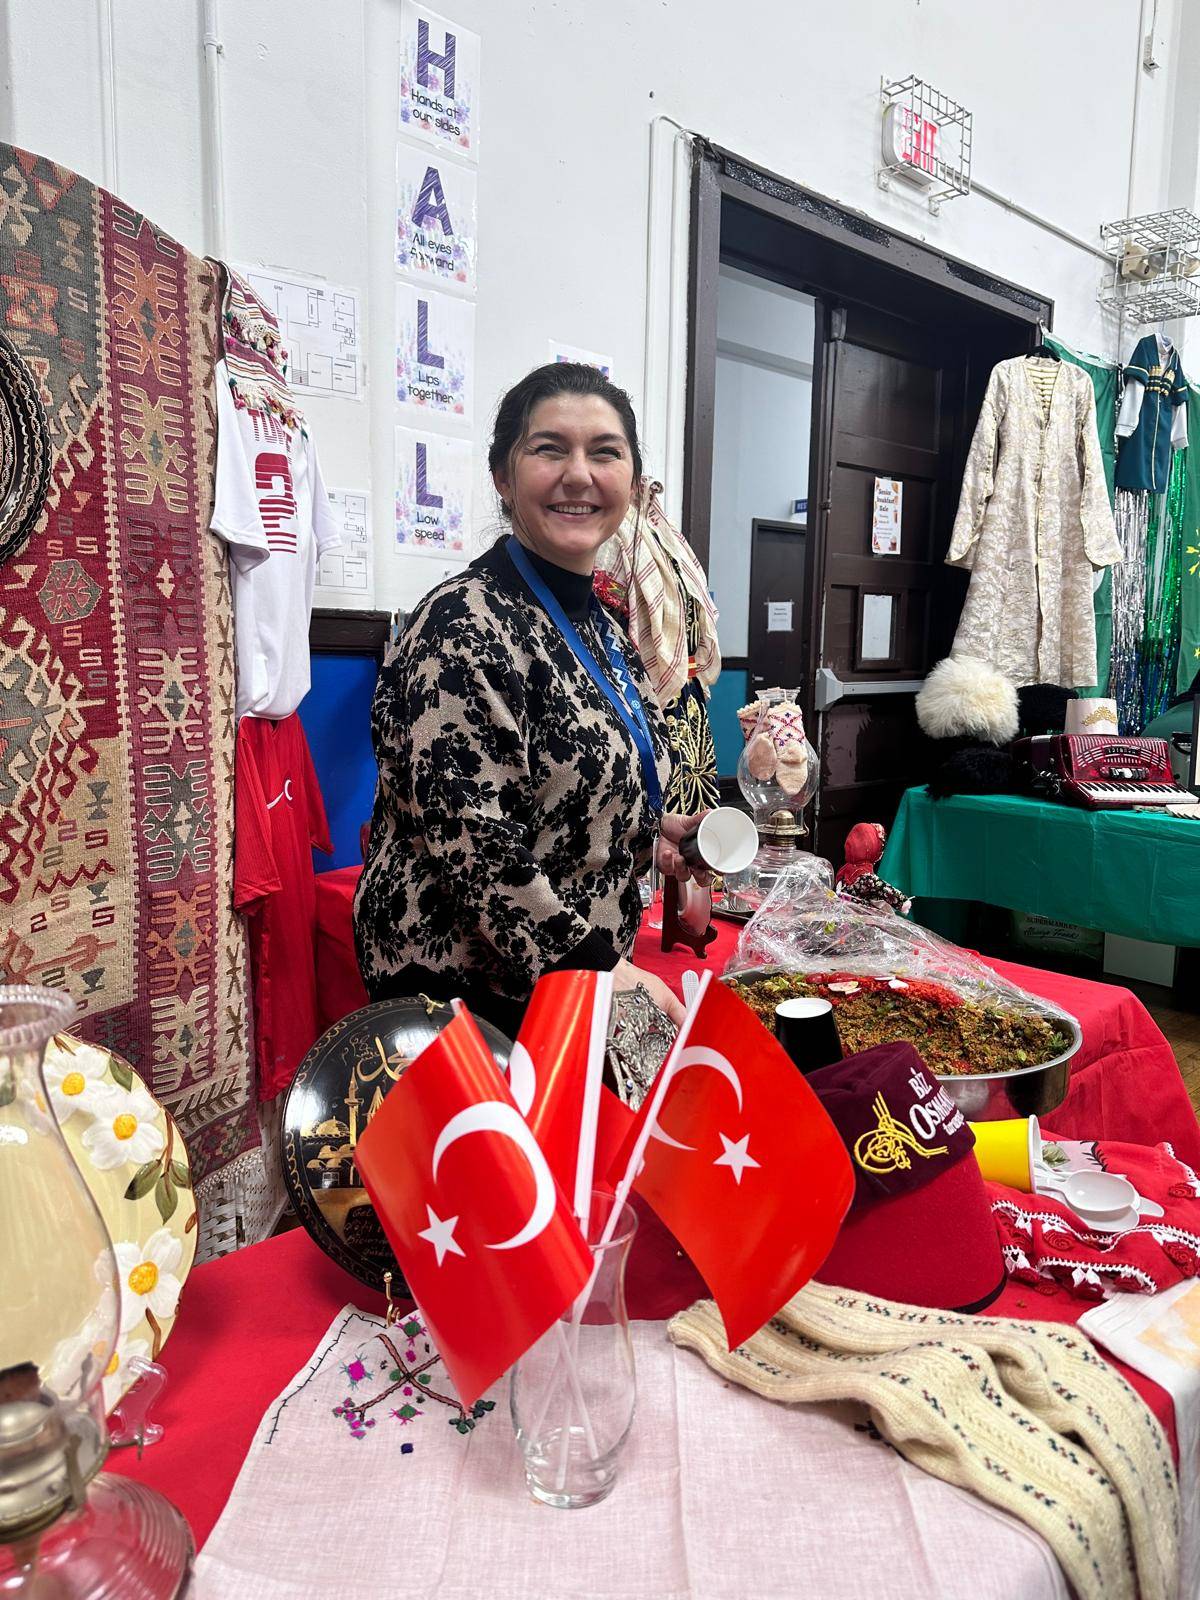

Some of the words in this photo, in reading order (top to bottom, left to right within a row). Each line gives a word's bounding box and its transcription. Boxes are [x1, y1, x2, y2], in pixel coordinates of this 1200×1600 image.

[417, 18, 456, 100] H
[411, 88, 443, 113] Hands
[445, 106, 460, 119] at
[412, 108, 432, 122] our
[434, 117, 460, 136] sides
[411, 166, 453, 236] A
[412, 232, 425, 247] All
[428, 240, 452, 254] eyes
[417, 299, 444, 370] L
[418, 370, 440, 386] Lips
[407, 383, 453, 403] together
[416, 442, 443, 509] L
[416, 511, 439, 525] Low
[414, 528, 445, 541] speed
